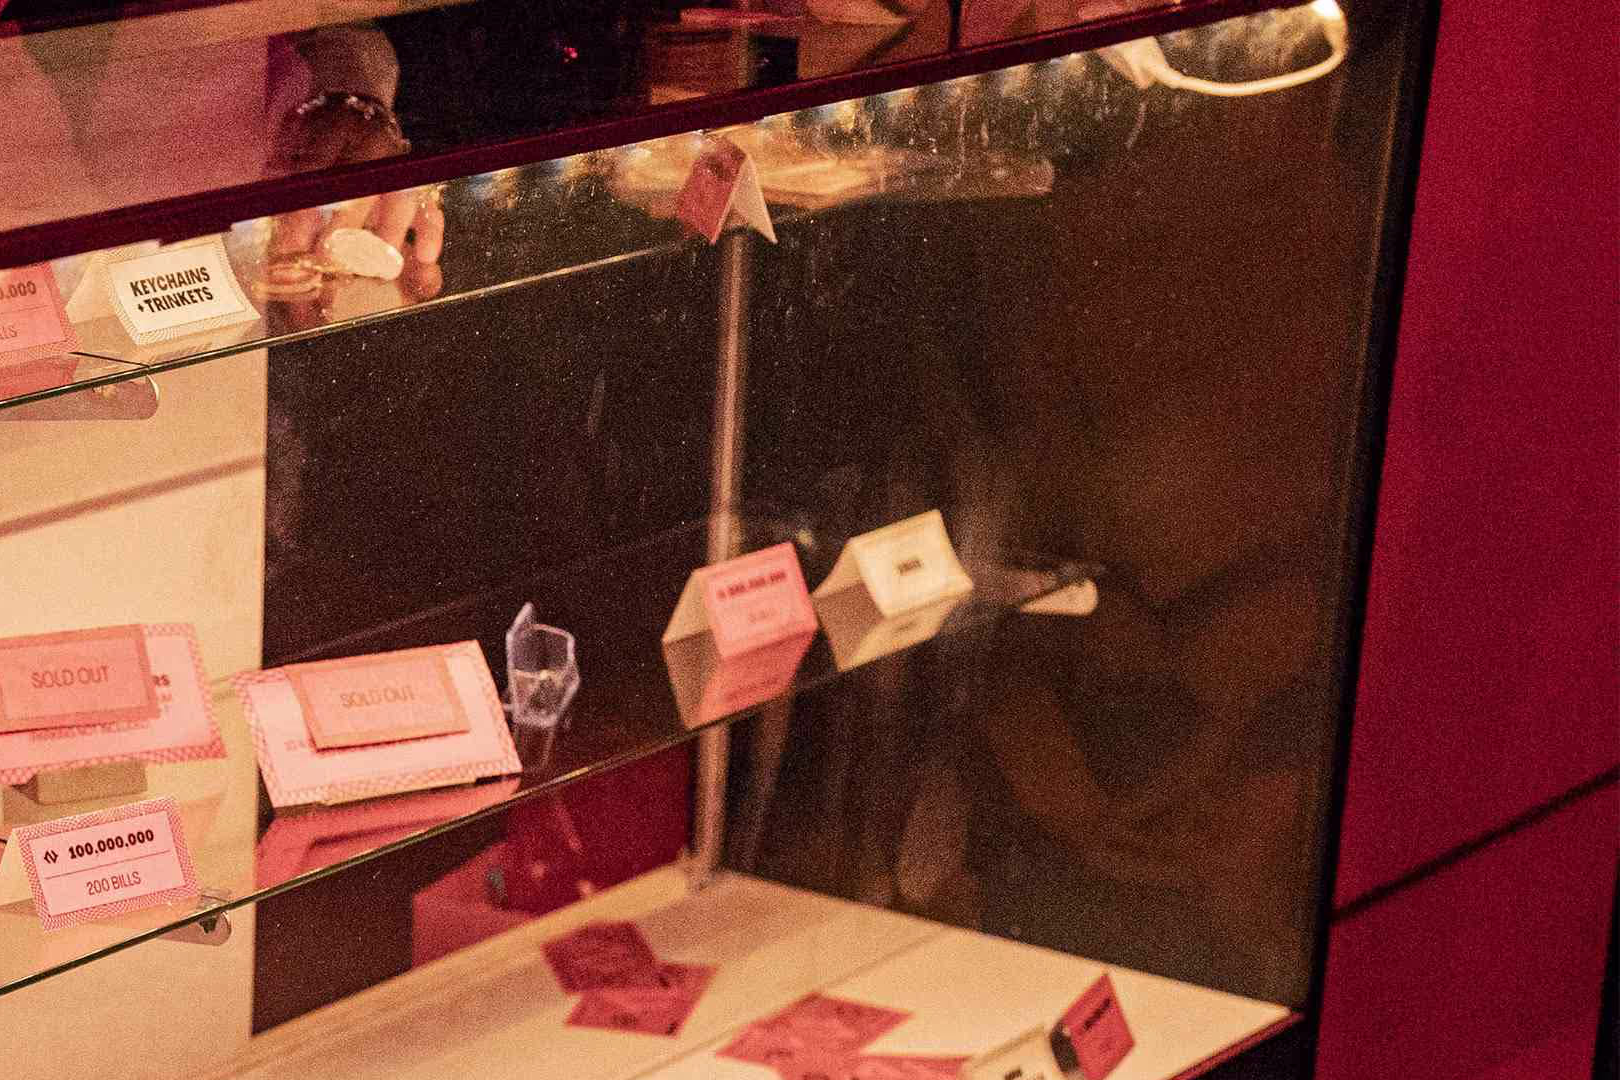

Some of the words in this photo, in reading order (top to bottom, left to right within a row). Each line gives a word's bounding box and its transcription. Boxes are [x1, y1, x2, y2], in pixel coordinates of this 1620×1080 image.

[130, 266, 211, 297] KEYCHAINS
[31, 668, 75, 689] SOLD
[77, 665, 110, 685] OUT
[68, 829, 155, 860] 100.000.000
[86, 878, 111, 896] 200
[111, 871, 142, 891] BILLS
